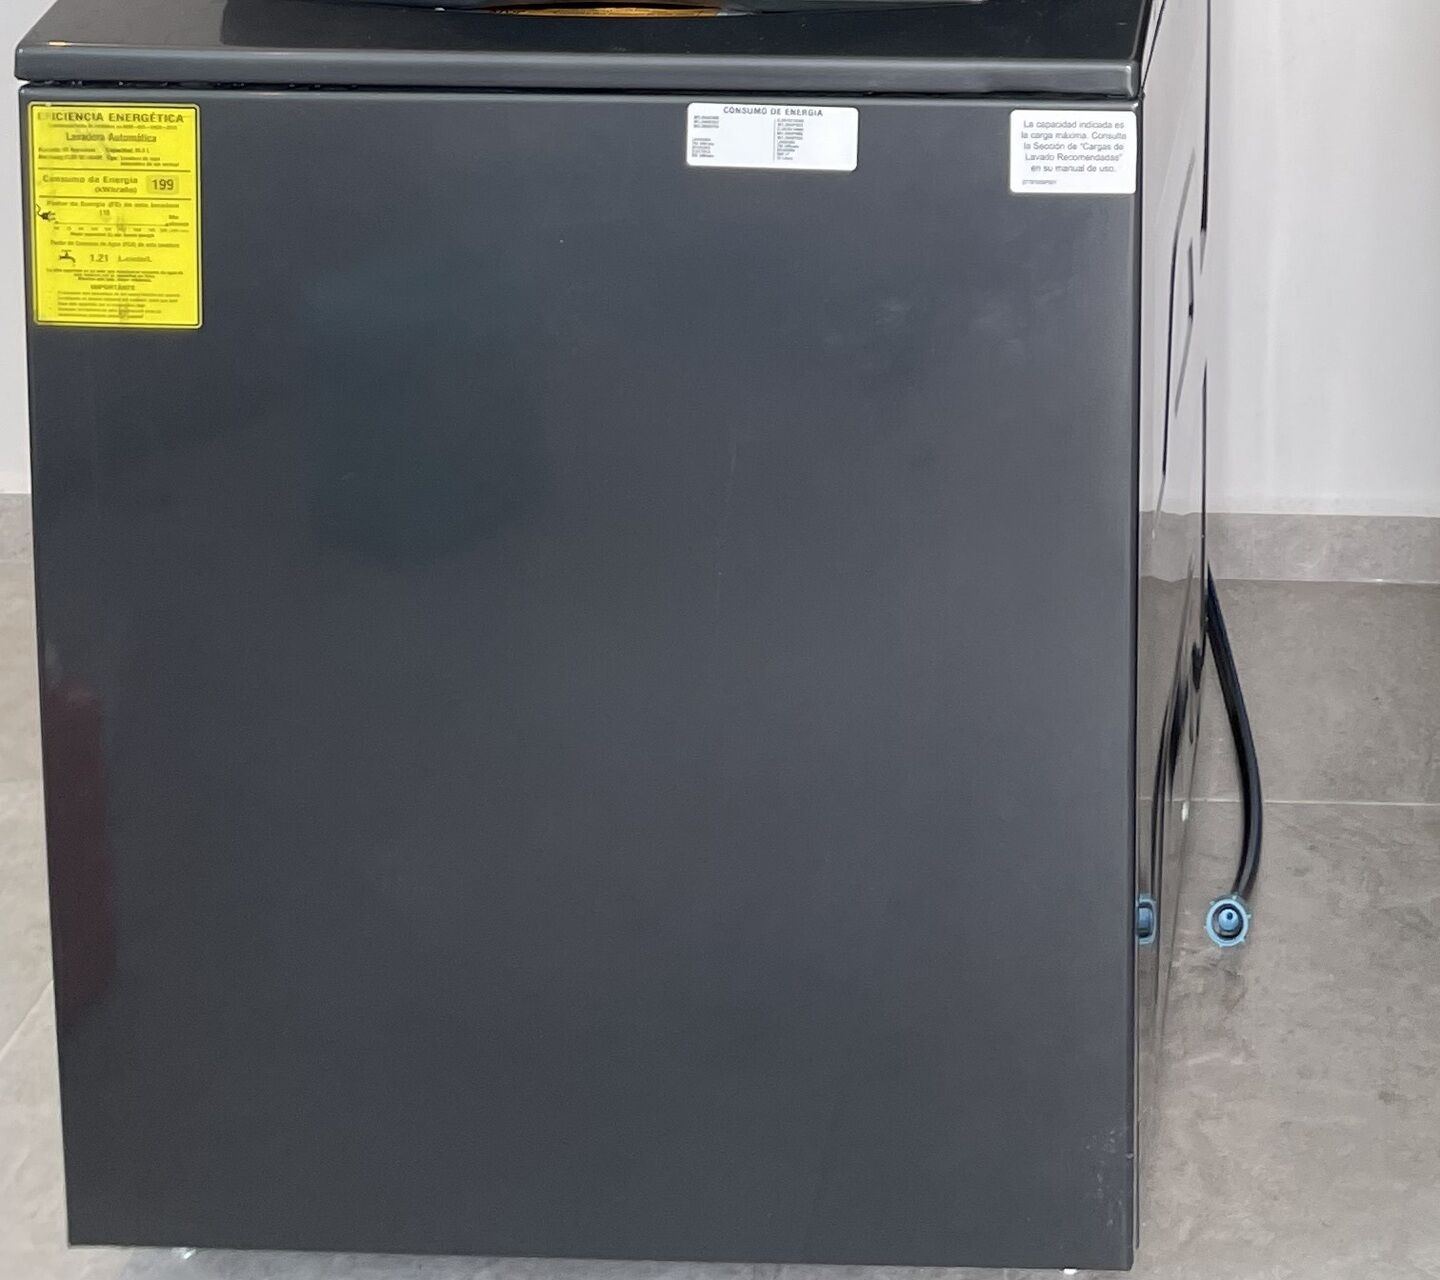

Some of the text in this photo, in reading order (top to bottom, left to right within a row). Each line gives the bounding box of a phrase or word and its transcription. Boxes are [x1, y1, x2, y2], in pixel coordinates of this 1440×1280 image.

[723, 106, 767, 115] CONSUMO
[770, 107, 781, 115] DE
[109, 112, 184, 122] ENERGÉTICA
[1036, 121, 1076, 129] capacidad
[66, 133, 157, 142] Lavadora Automática
[1031, 132, 1053, 140] carga
[1033, 142, 1065, 150] Sección
[43, 175, 85, 183] Consumo
[88, 175, 100, 183] de
[152, 179, 174, 190] 199
[90, 254, 109, 262] 1.21
